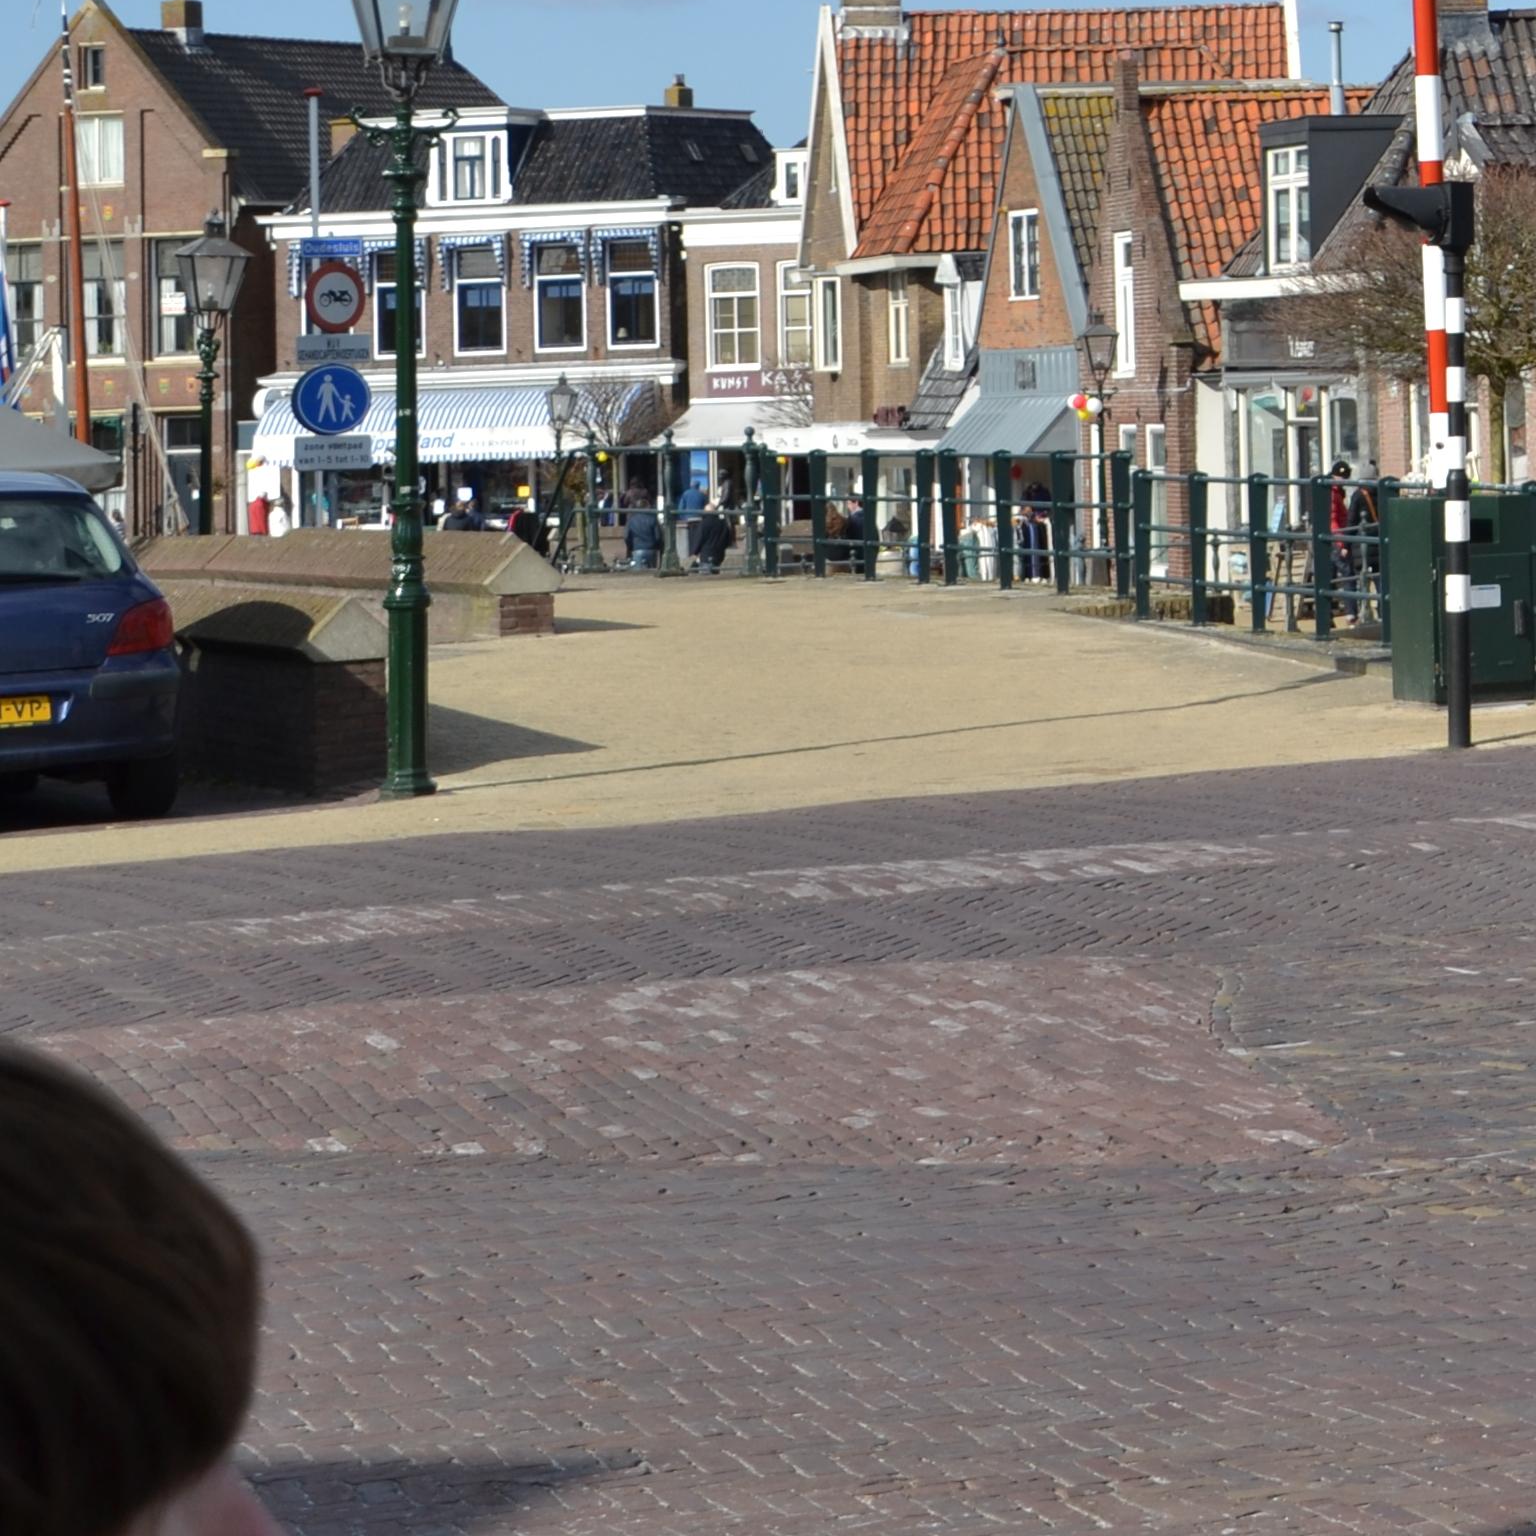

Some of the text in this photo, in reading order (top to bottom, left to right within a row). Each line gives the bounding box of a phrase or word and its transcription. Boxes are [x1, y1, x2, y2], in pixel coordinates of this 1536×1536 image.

[712, 376, 749, 391] KUNST
[86, 613, 115, 624] 307
[0, 700, 42, 719] -VP
